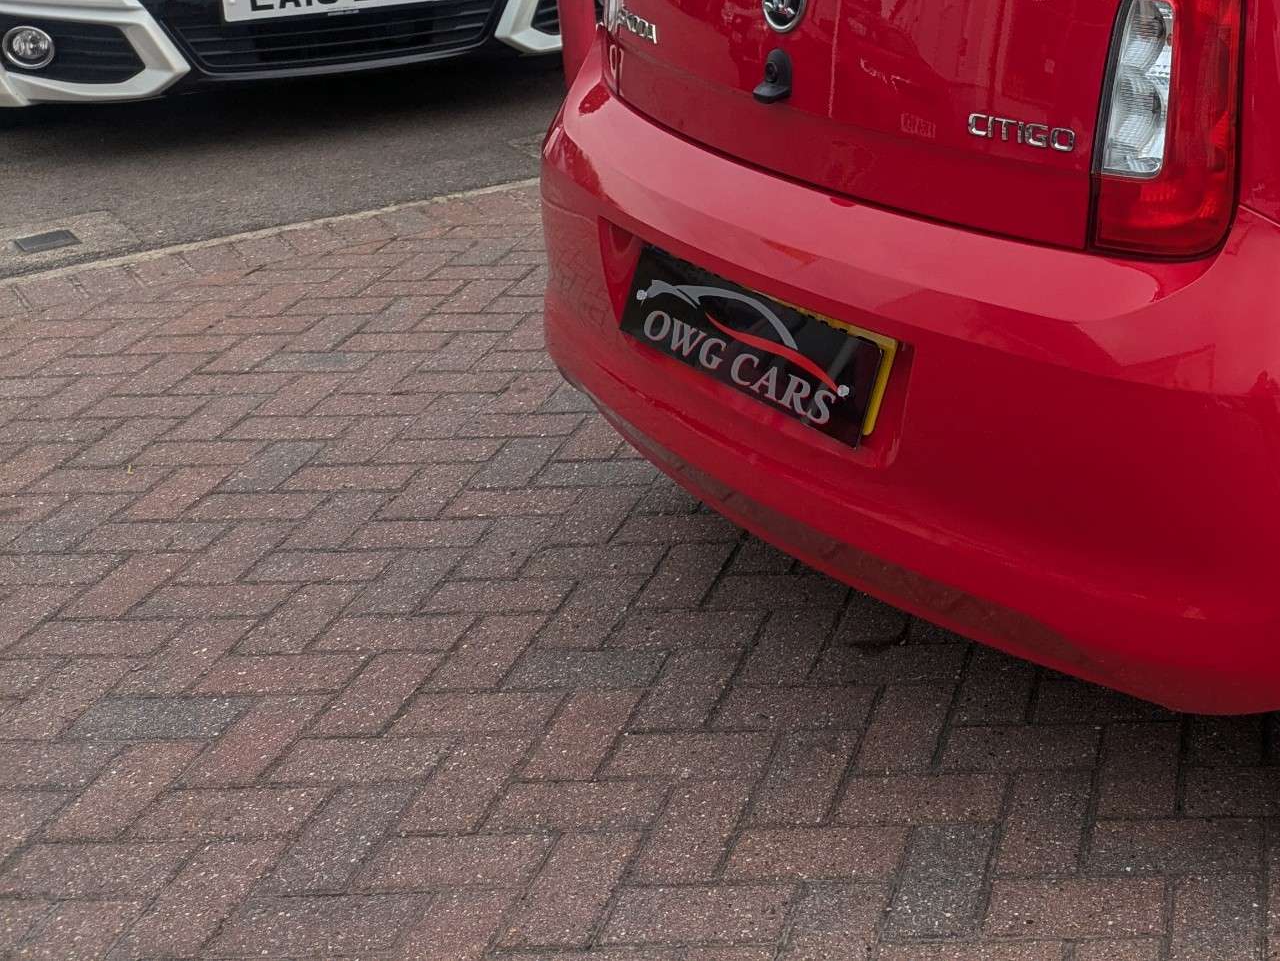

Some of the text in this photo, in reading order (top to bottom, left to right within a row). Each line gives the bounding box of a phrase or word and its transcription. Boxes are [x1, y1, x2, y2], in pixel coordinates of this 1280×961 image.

[967, 112, 1076, 152] CITIGO
[643, 310, 837, 425] OWG CARS
